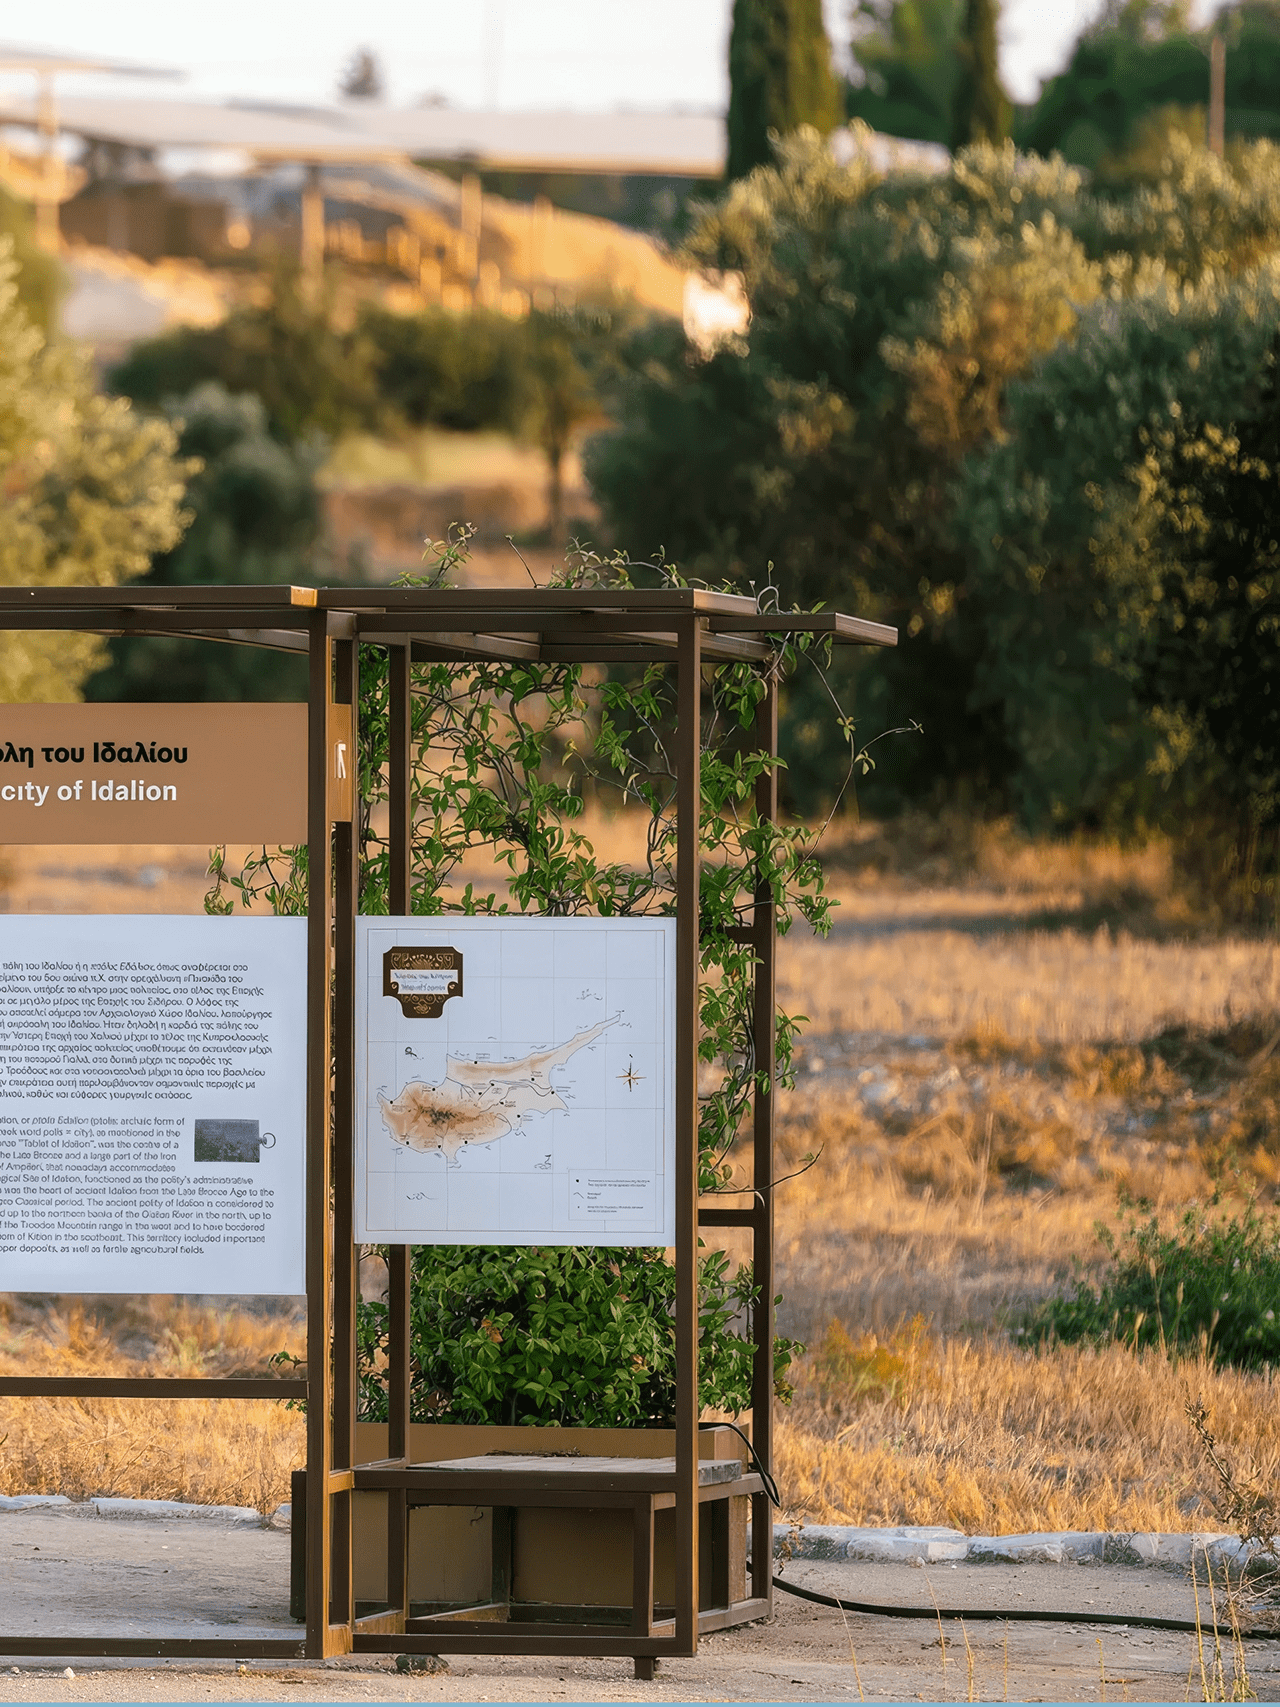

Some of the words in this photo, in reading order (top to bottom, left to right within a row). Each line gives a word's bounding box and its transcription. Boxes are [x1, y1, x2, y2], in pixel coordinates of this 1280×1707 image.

[41, 746, 85, 764] του
[93, 741, 188, 764] Ιδαλίου
[1, 779, 50, 807] city
[57, 779, 84, 801] of
[91, 779, 177, 801] Idalion
[176, 1117, 184, 1125] of
[166, 1129, 180, 1137] the
[51, 1140, 59, 1148] of
[117, 1140, 131, 1148] the
[163, 1140, 171, 1148] of
[133, 1152, 142, 1160] of
[144, 1152, 158, 1160] the
[41, 1174, 49, 1182] of
[145, 1175, 158, 1183] the
[23, 1186, 37, 1194] the
[64, 1186, 73, 1194] of
[161, 1187, 176, 1195] the
[249, 1188, 258, 1196] to
[260, 1188, 274, 1196] the
[87, 1197, 103, 1205] The
[165, 1199, 174, 1207] of
[265, 1200, 274, 1208] to
[7, 1210, 19, 1218] up
[21, 1209, 29, 1217] to
[32, 1209, 46, 1217] the
[114, 1210, 123, 1218] of
[125, 1210, 139, 1218] the
[205, 1210, 220, 1218] the
[249, 1212, 261, 1220] up
[263, 1211, 271, 1219] to
[4, 1221, 18, 1229] the
[135, 1222, 149, 1230] the
[193, 1222, 201, 1230] to
[17, 1233, 25, 1241] of
[64, 1232, 78, 1240] the
